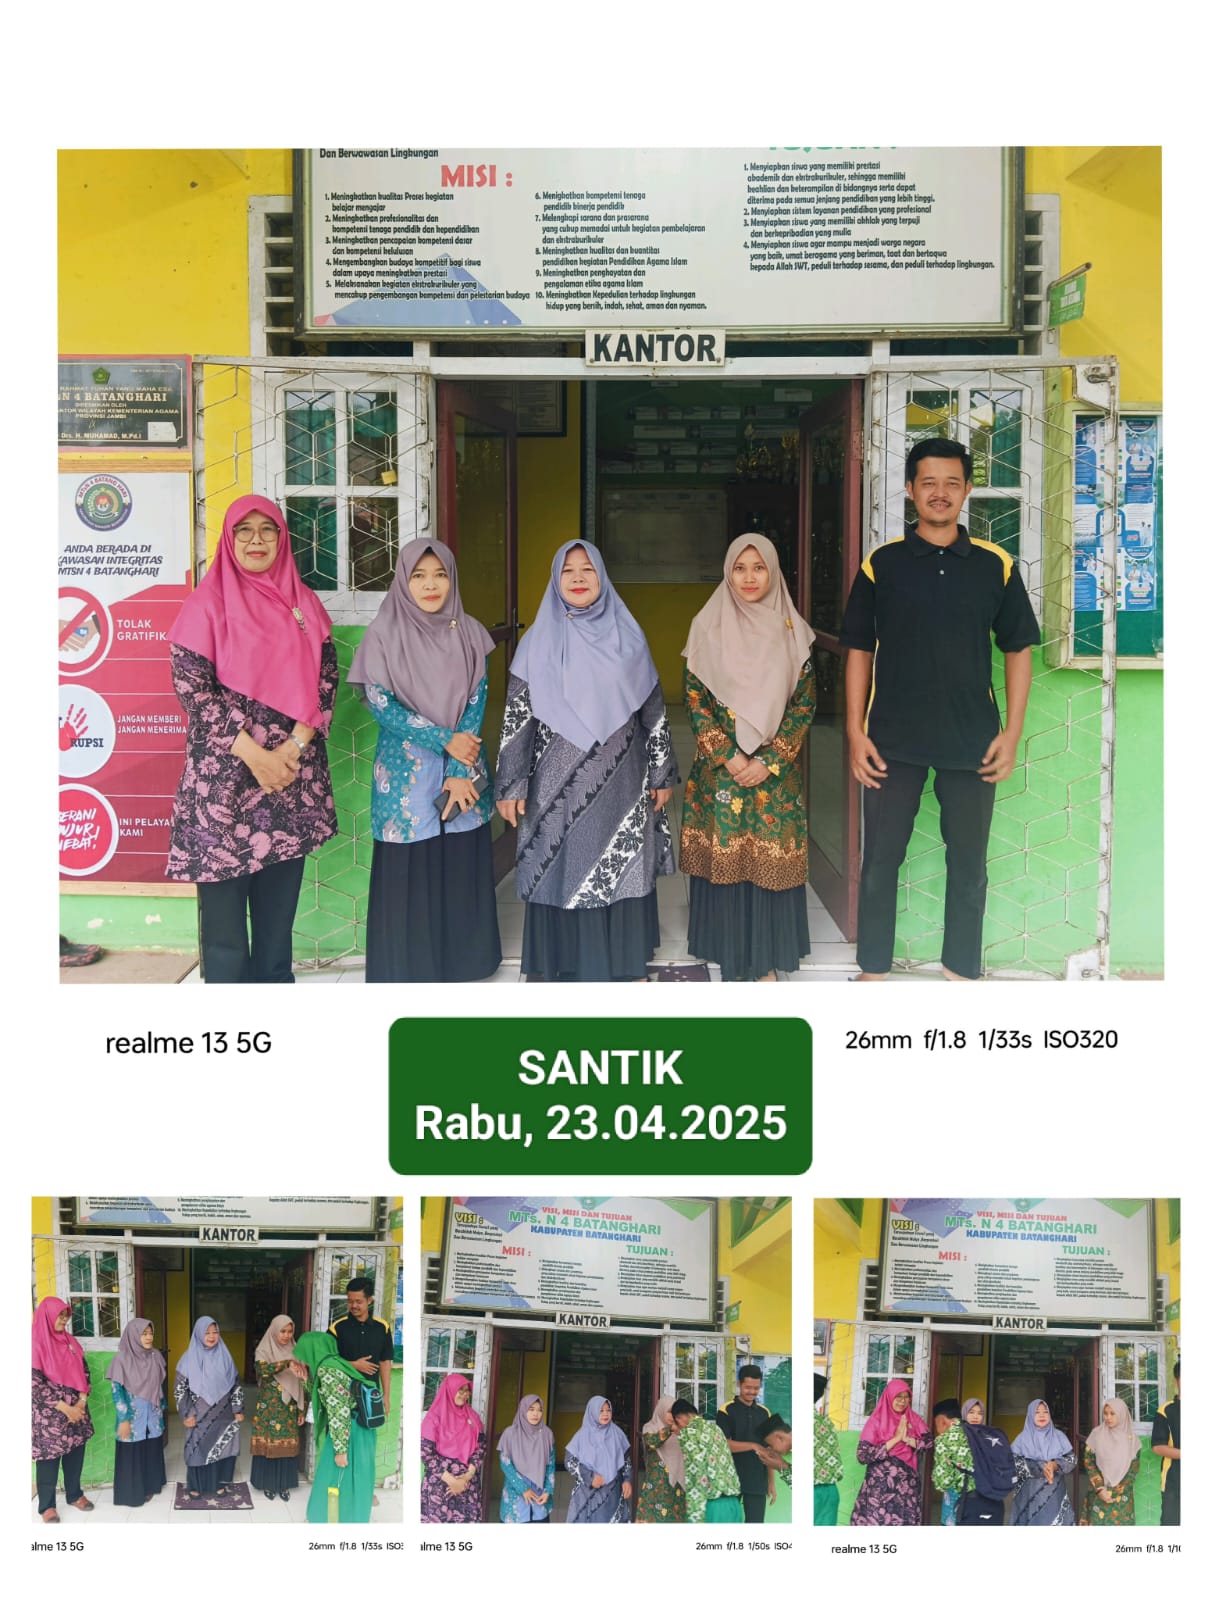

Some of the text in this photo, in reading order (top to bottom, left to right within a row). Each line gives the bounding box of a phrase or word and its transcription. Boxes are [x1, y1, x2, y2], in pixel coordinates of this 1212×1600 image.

[320, 148, 438, 159] Dan Berwawasan Lingkungan
[441, 164, 496, 187] MISI
[332, 203, 386, 213] belajar mengajar
[544, 203, 625, 212] pendidik kinerja pendidik
[332, 226, 368, 234] kompetensi
[369, 226, 392, 234] tenaga
[393, 226, 421, 234] pendidik
[436, 226, 480, 235] kependidikan
[750, 229, 763, 238] dan
[764, 229, 814, 239] berkepribadian
[815, 230, 832, 238] yang
[346, 248, 382, 256] kompetensi
[750, 253, 767, 261] yang
[768, 251, 784, 260] baik,
[786, 251, 803, 260] umat
[804, 251, 838, 260] beragama
[839, 251, 856, 260] yang
[856, 250, 886, 259] beriman,
[887, 250, 901, 258] taat
[916, 250, 947, 259] bertaqwa
[542, 258, 578, 267] pendidikan
[579, 258, 608, 268] kegiatan
[646, 258, 670, 267] Agama
[671, 258, 688, 266] Islam
[750, 263, 775, 272] kepada
[776, 263, 793, 271] Allah
[794, 262, 810, 271] SWT,
[811, 262, 831, 271] peduli
[832, 262, 863, 271] terhadap
[864, 262, 890, 270] sesama,
[904, 261, 925, 270] peduli
[926, 261, 956, 270] terhadap
[956, 261, 995, 270] lingkungan.
[332, 269, 447, 278] dalam upaya meningkatkan prestasi
[546, 302, 564, 311] hidup
[565, 303, 581, 312] yang
[582, 302, 603, 310] bersih,
[604, 302, 625, 310] indah,
[626, 302, 645, 310] sehat,
[665, 302, 678, 310] dan
[679, 303, 707, 311] nyaman.
[594, 334, 716, 362] KANTOR
[85, 392, 167, 402] BATANGHARI
[64, 545, 151, 554] ANDA BERADA DI
[106, 556, 163, 566] INTEGRITAS
[86, 567, 90, 575] 4
[94, 567, 160, 577] BATANGHARI
[117, 620, 152, 628] TOLAK
[117, 631, 168, 640] GRATIFIK
[118, 715, 182, 724] JANGAN MEMBERI
[118, 726, 187, 734] JANGAN MENERIMA
[120, 818, 132, 826] INI
[455, 1212, 478, 1224] VISI
[602, 1211, 633, 1221] TUJUAN
[509, 1211, 661, 1235] MTs. N 4 BATANGHARI
[892, 1219, 913, 1230] VISI
[945, 1216, 1097, 1235] MTs. N 4 BATANGHARI
[202, 1227, 255, 1241] KANTOR
[530, 1225, 641, 1243] KABUPATEN BATANGHARI
[966, 1229, 1077, 1242] KABUPATEN BATANGHARI
[502, 1246, 525, 1256] MISI
[626, 1244, 669, 1256] TUJUAN
[1062, 1246, 1105, 1256] TUJUAN
[938, 1251, 961, 1261] MISI
[559, 1312, 607, 1327] KANTOR
[995, 1317, 1044, 1329] KANTOR
